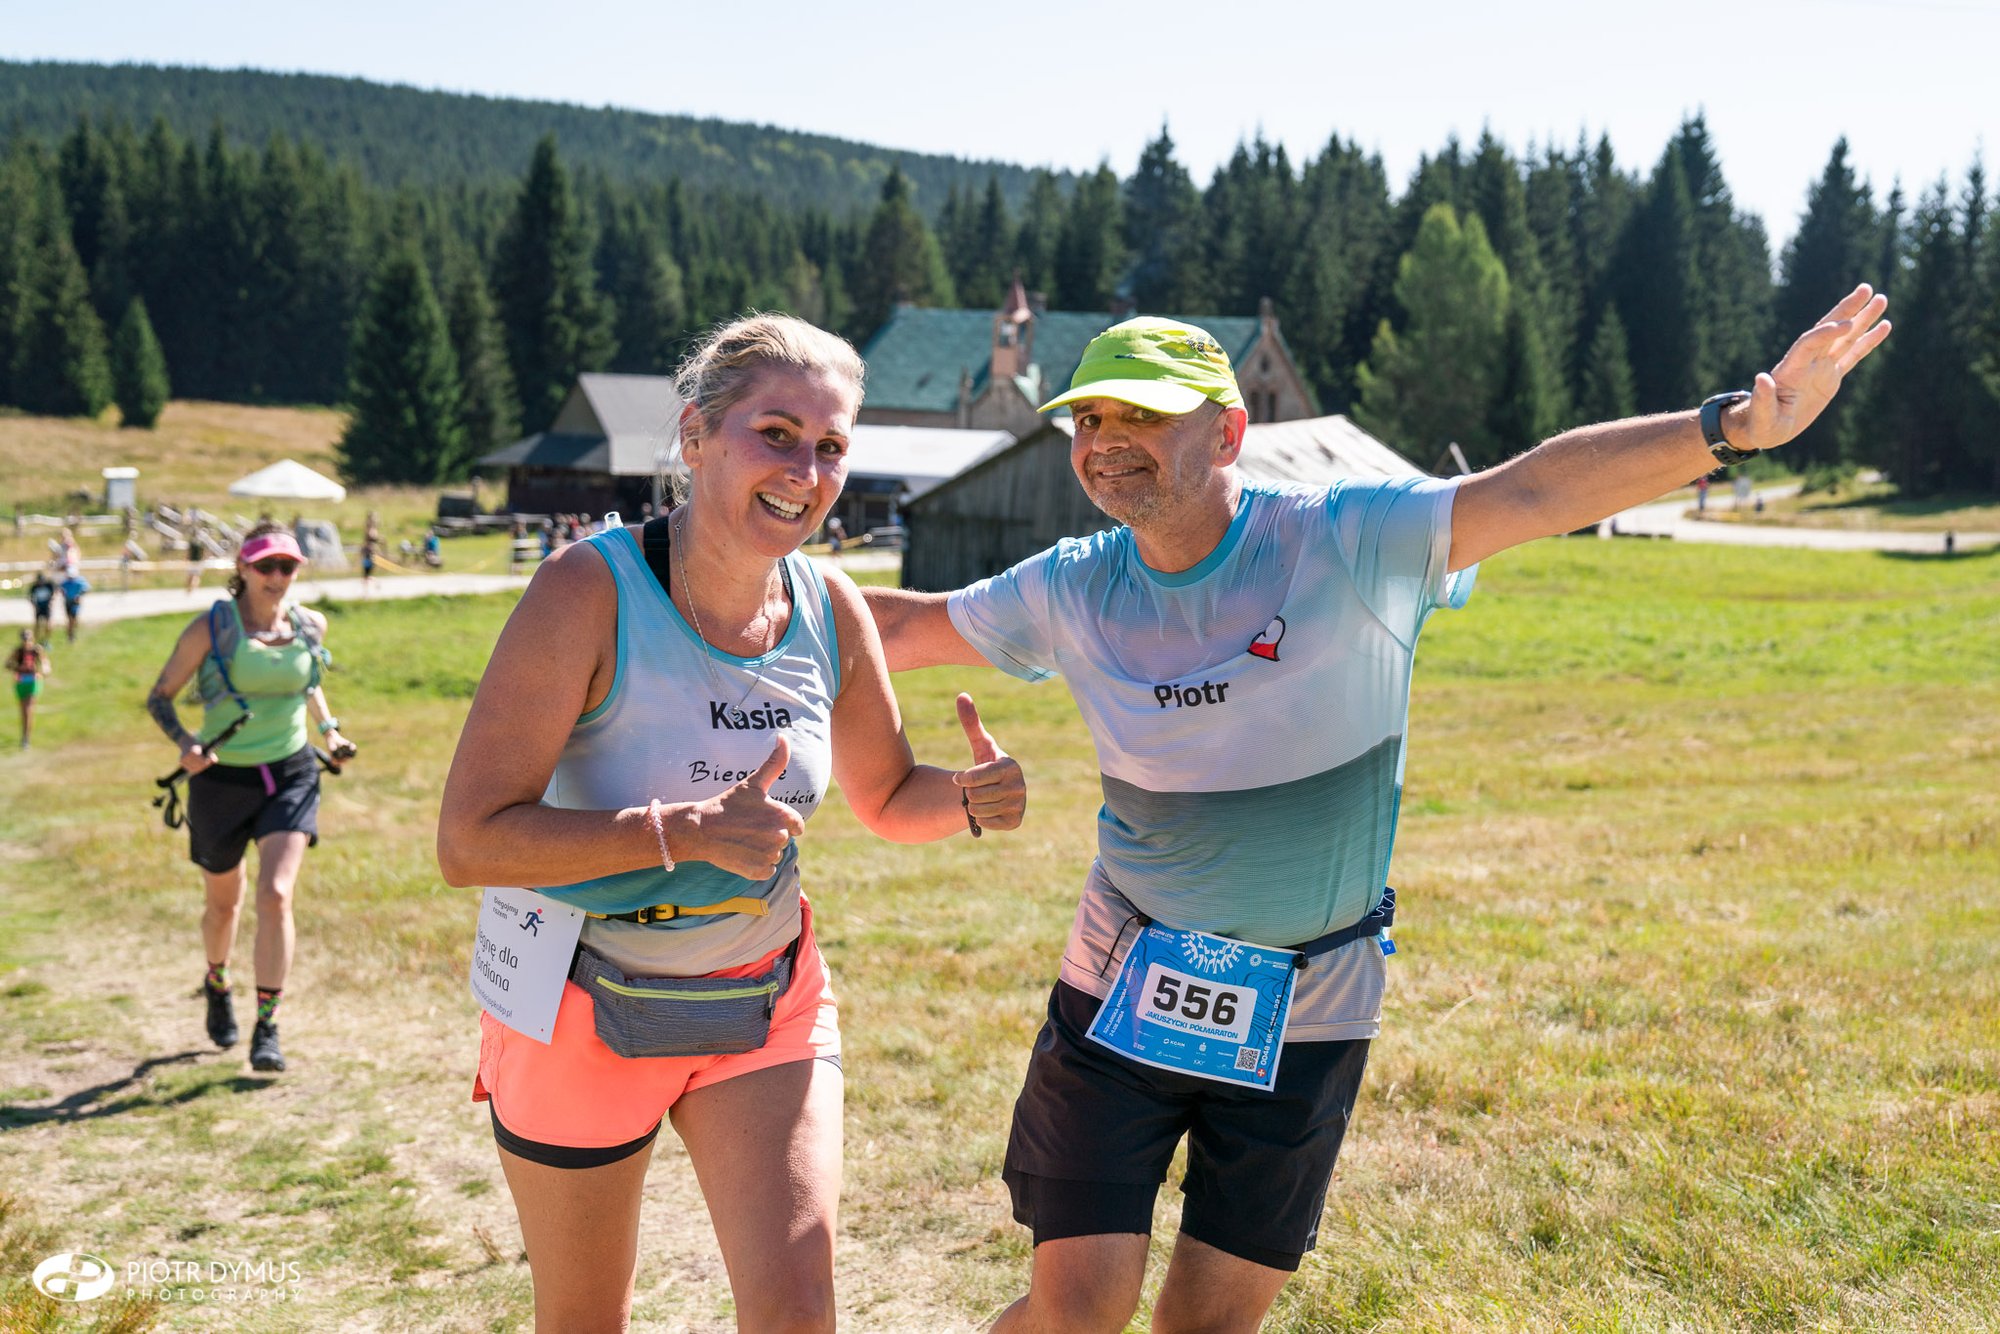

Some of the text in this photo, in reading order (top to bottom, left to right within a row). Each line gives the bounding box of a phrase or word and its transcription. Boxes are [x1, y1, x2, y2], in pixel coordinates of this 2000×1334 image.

[1154, 680, 1229, 708] Piotr
[710, 701, 792, 730] Kasia
[498, 946, 518, 969] dla
[1152, 974, 1239, 1026] 556
[1145, 1010, 1188, 1029] JAKUSZYCKI
